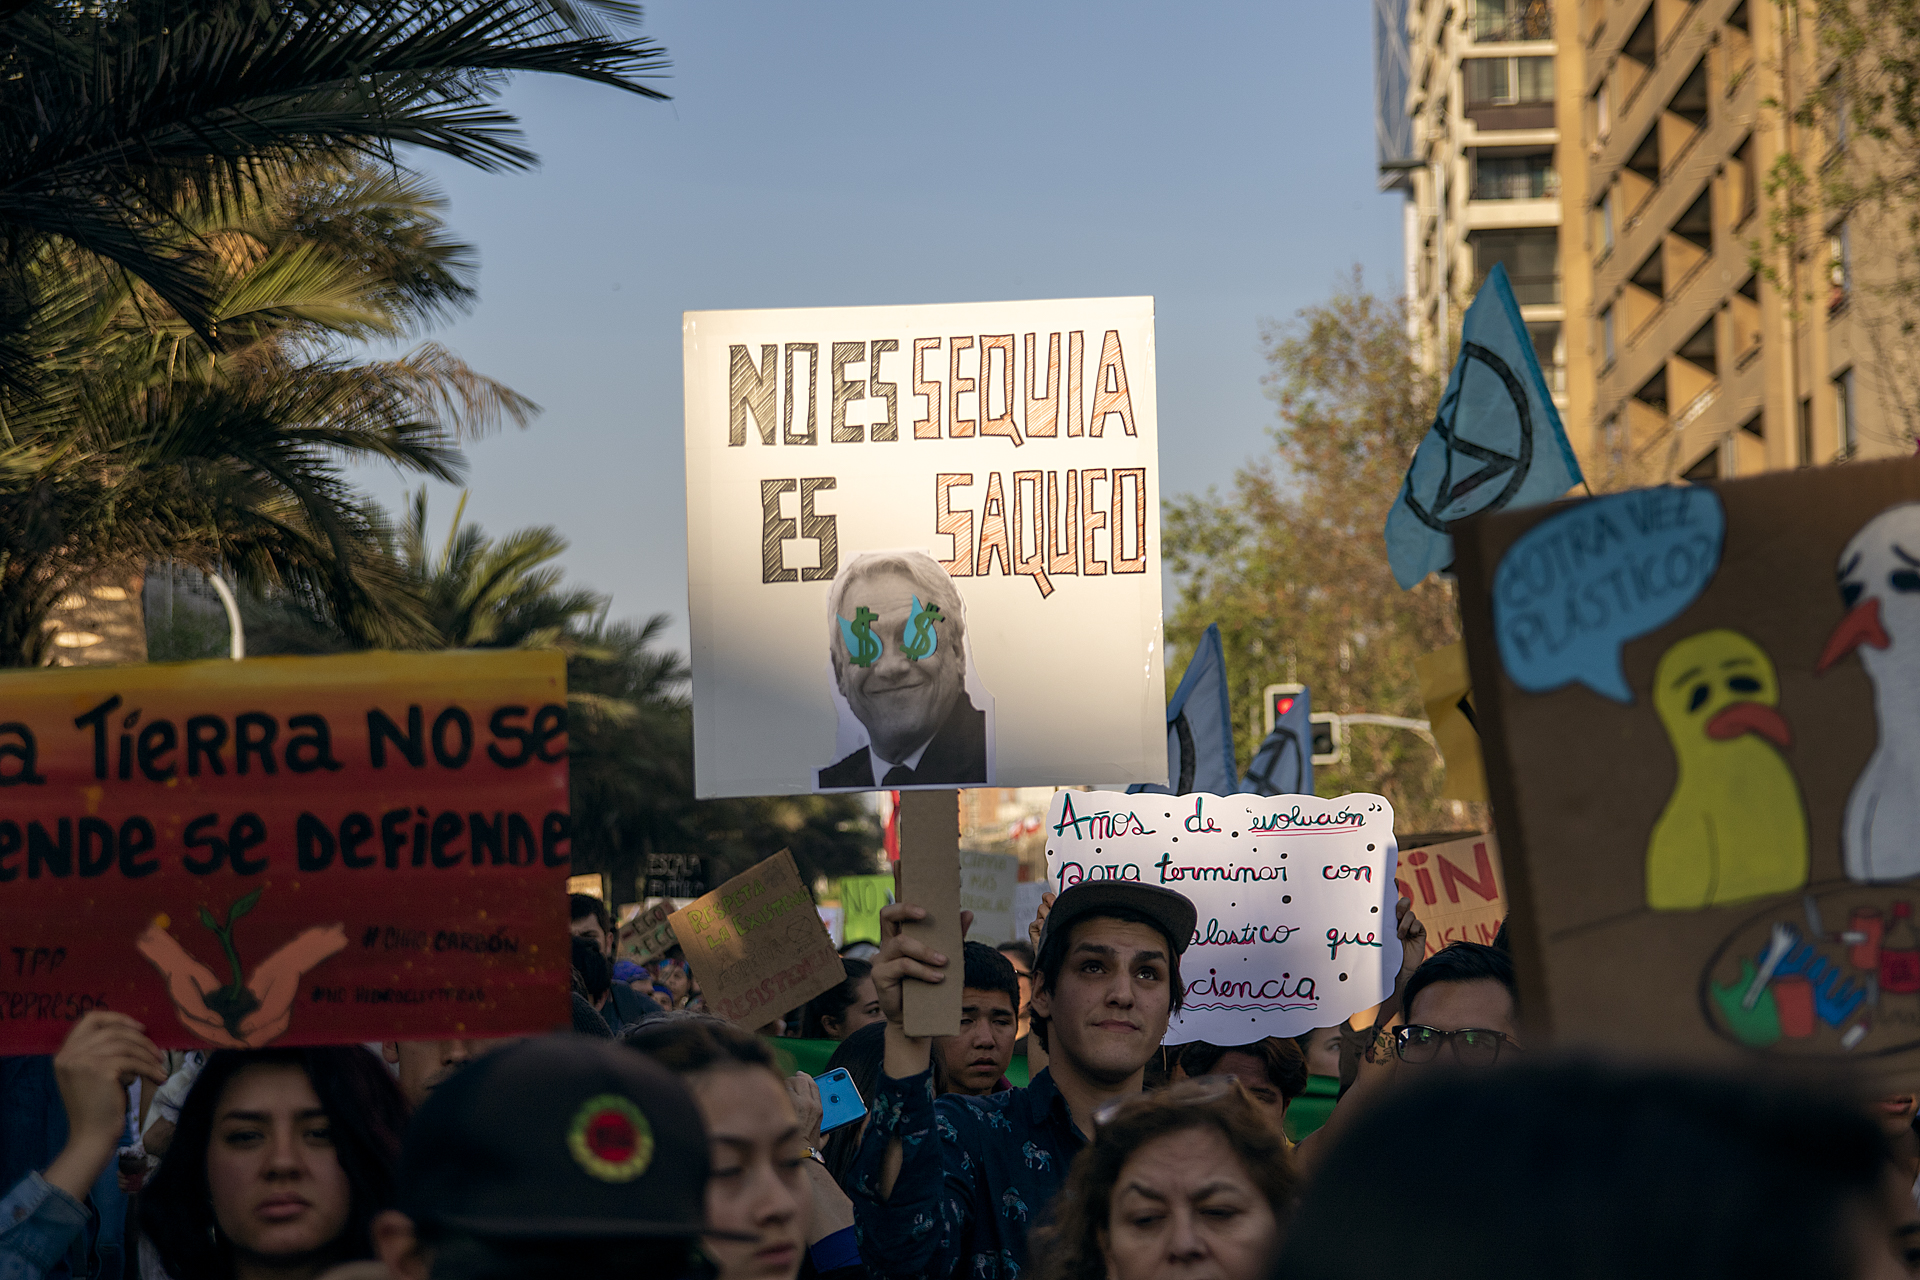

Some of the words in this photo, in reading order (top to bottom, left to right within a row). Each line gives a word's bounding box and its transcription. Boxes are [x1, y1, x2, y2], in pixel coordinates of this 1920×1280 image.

[728, 342, 818, 446] NO
[831, 339, 899, 443] ES
[912, 329, 1138, 447] SEQUIA
[760, 477, 838, 583] ES
[935, 467, 1146, 599] SAQUEO
[366, 706, 474, 770] NO
[1053, 793, 1156, 840] Años
[1184, 797, 1222, 834] de
[1057, 861, 1141, 895] para
[1154, 853, 1288, 884] terminar
[1322, 865, 1372, 884] con
[687, 879, 766, 934] RESPETA
[841, 880, 877, 915] NO
[706, 926, 731, 949] LA
[1326, 928, 1383, 961] que
[12, 946, 67, 976] TPP
[1184, 968, 1320, 1000] ciencia.
